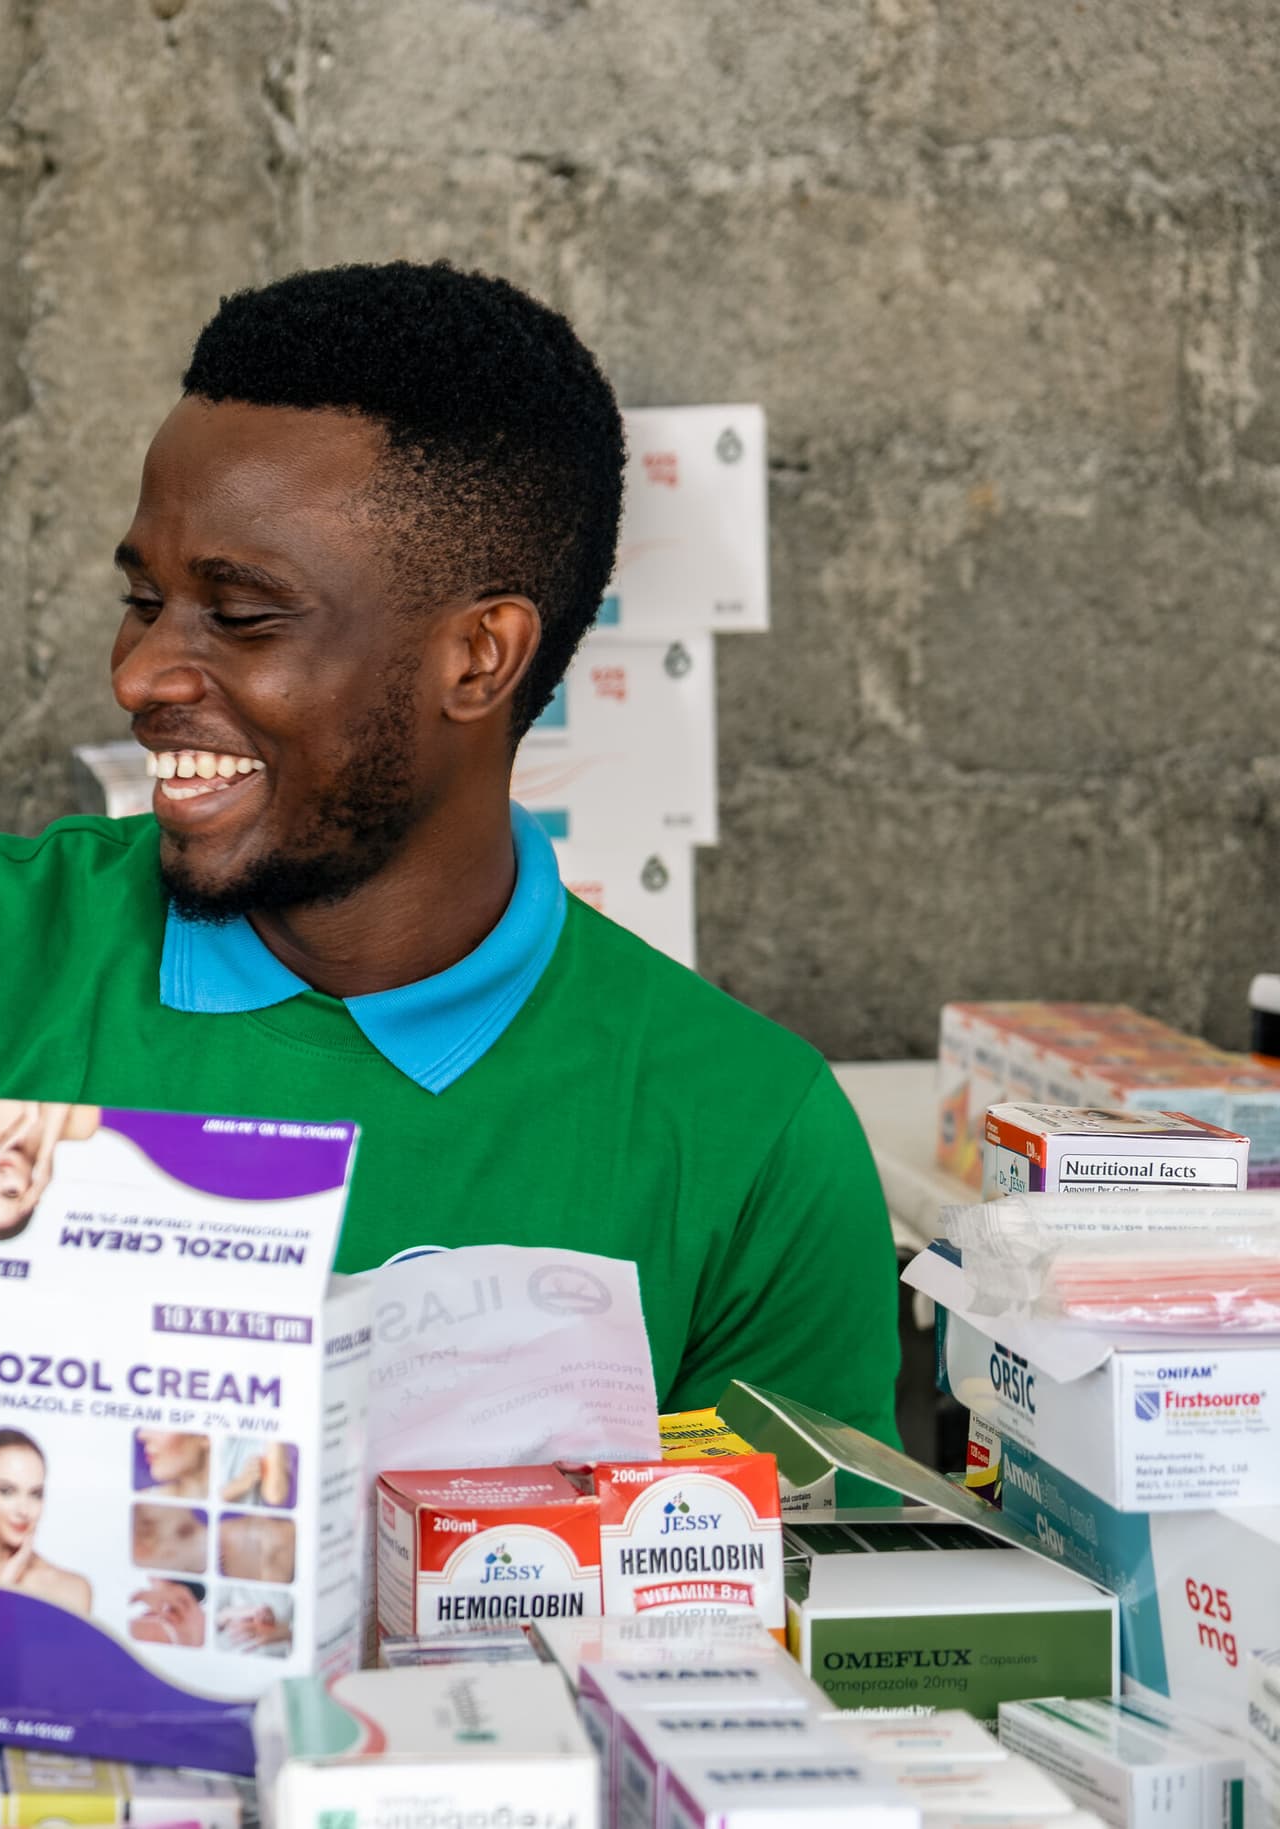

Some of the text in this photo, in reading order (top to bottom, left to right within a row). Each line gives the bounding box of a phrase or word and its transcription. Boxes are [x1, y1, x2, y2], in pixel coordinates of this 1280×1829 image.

[1065, 1160, 1197, 1178] Nutritional facts
[59, 1225, 306, 1266] NITOZOL CREAM
[161, 1306, 307, 1341] 10 X 1 X 15 gm
[989, 1352, 1036, 1415] ORSIC
[1157, 1366, 1213, 1380] ONIFAM
[127, 1364, 282, 1407] CREAM
[1164, 1390, 1261, 1409] Firstsource
[90, 1400, 163, 1423] CREAM
[169, 1408, 194, 1426] BP
[611, 1468, 654, 1484] 200ml
[432, 1517, 479, 1533] 200ml
[660, 1513, 722, 1535] JESSY
[619, 1543, 765, 1576] HEMOGLOBIN
[480, 1564, 545, 1584] JESSY
[641, 1583, 717, 1605] VITAMIN
[1185, 1576, 1232, 1623] 625
[437, 1592, 585, 1621] HEMOGLOBIN
[1197, 1621, 1238, 1667] mg
[823, 1649, 1039, 1672] OMEFLUX Capsules
[823, 1675, 969, 1695] Omeprazole 20mg
[841, 1704, 917, 1719] nufactured
